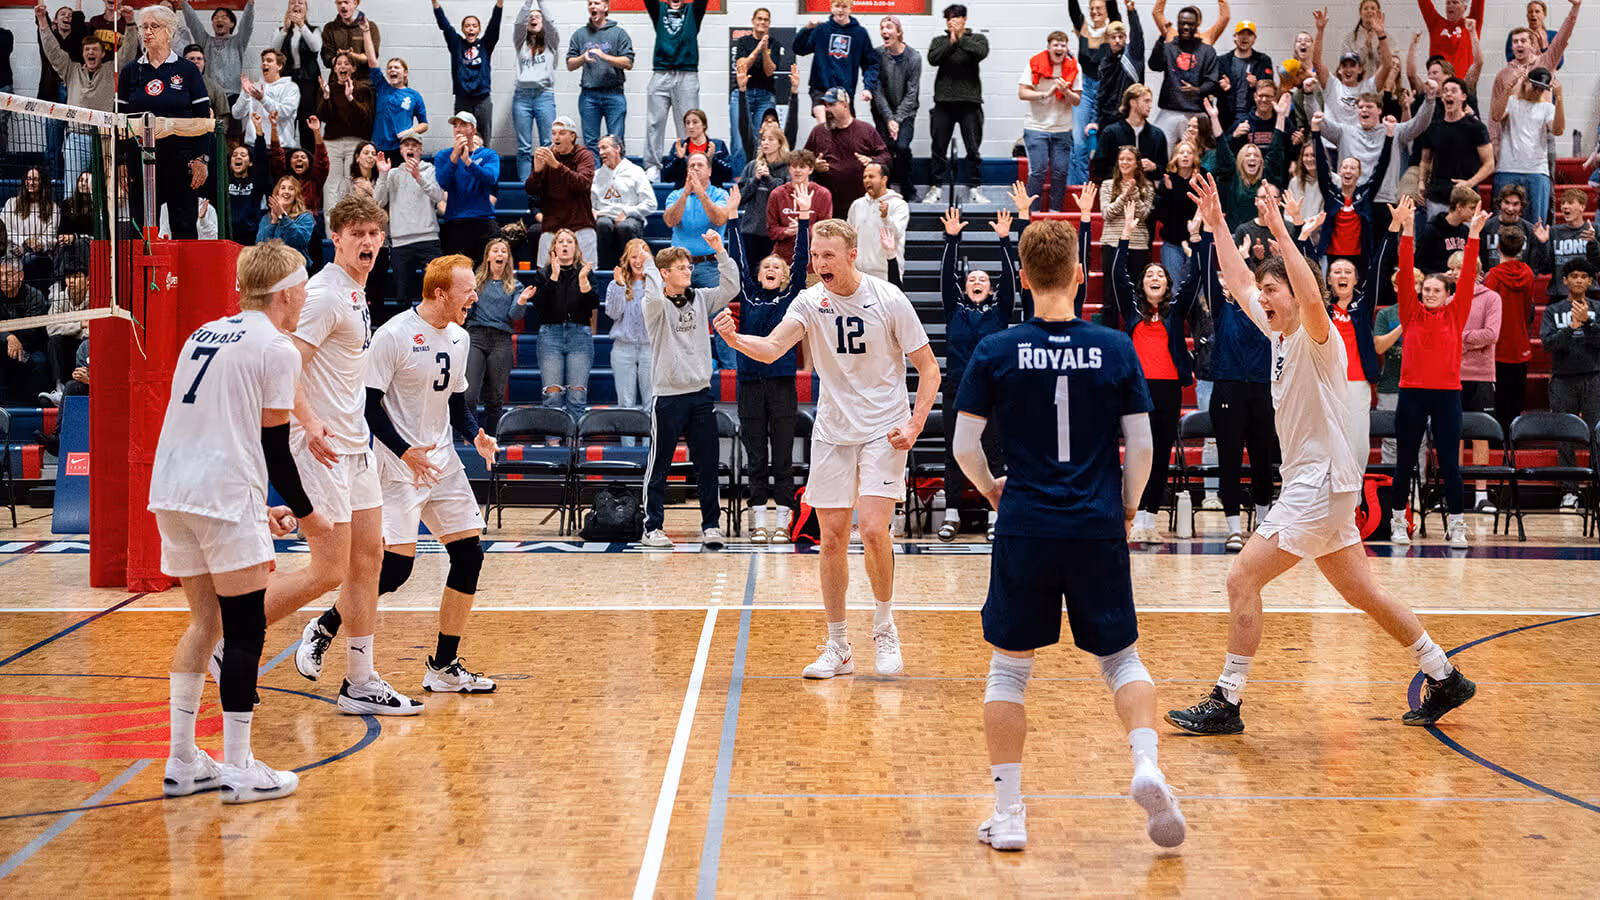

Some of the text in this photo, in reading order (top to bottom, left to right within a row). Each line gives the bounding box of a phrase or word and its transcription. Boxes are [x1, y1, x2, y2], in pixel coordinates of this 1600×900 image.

[836, 316, 866, 354] 12
[182, 346, 220, 404] 7
[433, 352, 450, 391] 3
[1018, 347, 1103, 370] ROYALS
[1054, 375, 1071, 462] 1
